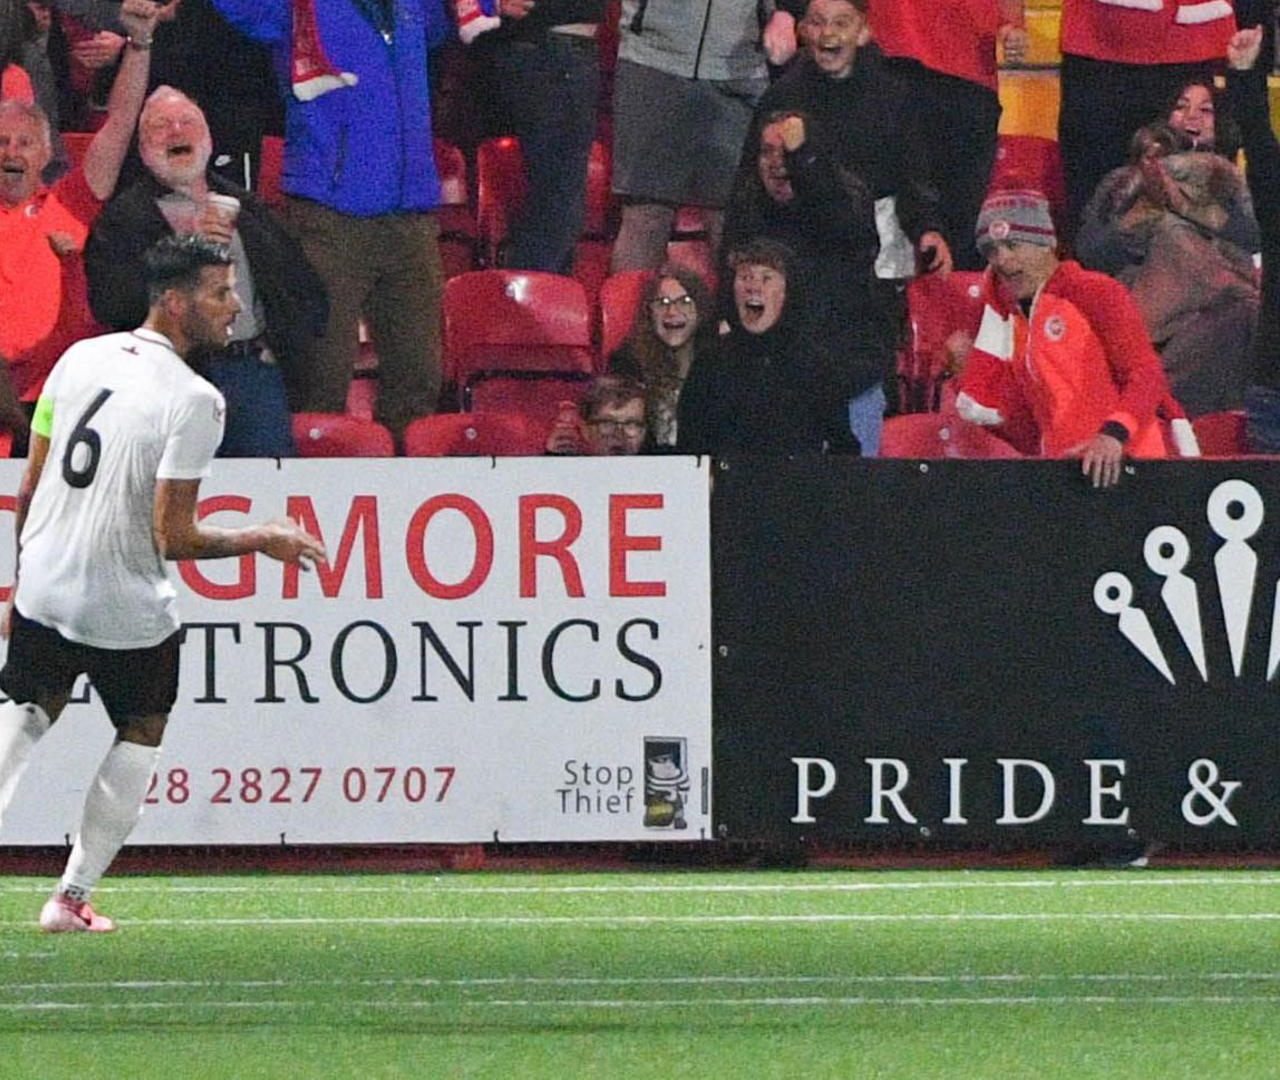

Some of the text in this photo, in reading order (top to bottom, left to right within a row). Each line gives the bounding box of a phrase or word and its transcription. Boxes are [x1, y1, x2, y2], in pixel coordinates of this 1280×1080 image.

[62, 387, 114, 488] 6
[144, 767, 456, 804] 28 2827 0707
[564, 759, 633, 790] Stop
[790, 757, 1242, 827] PRIDE &
[556, 788, 635, 815] Thief
